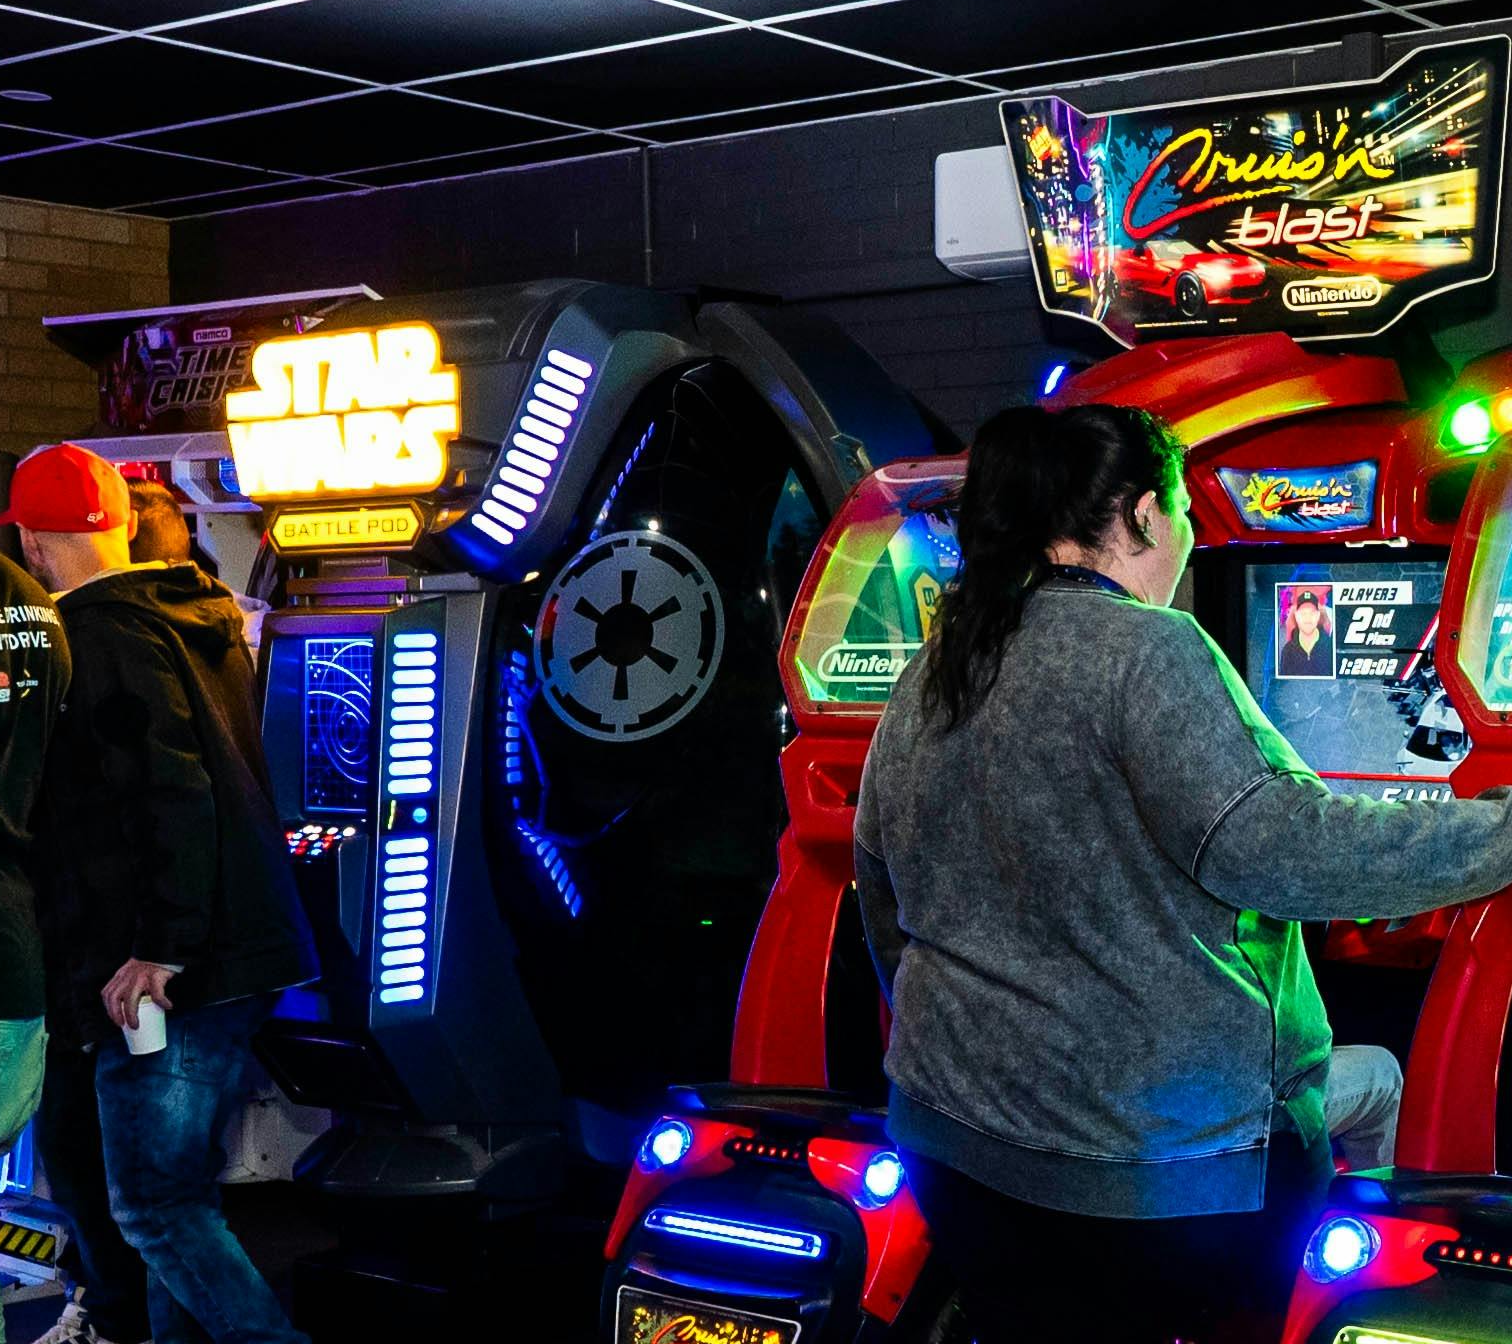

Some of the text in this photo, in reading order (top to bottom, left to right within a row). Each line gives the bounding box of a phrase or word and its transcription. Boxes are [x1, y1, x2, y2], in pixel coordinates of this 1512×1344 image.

[1239, 195, 1384, 247] blast
[1290, 283, 1374, 306] Nintendo
[195, 329, 230, 341] namco
[176, 342, 255, 376] TIME
[226, 320, 461, 421] STAR
[227, 403, 461, 502] WARS
[1298, 500, 1351, 517] blast
[283, 516, 410, 539] BATTLE POD
[1344, 606, 1395, 645] 2nd
[828, 652, 904, 673] Ninten
